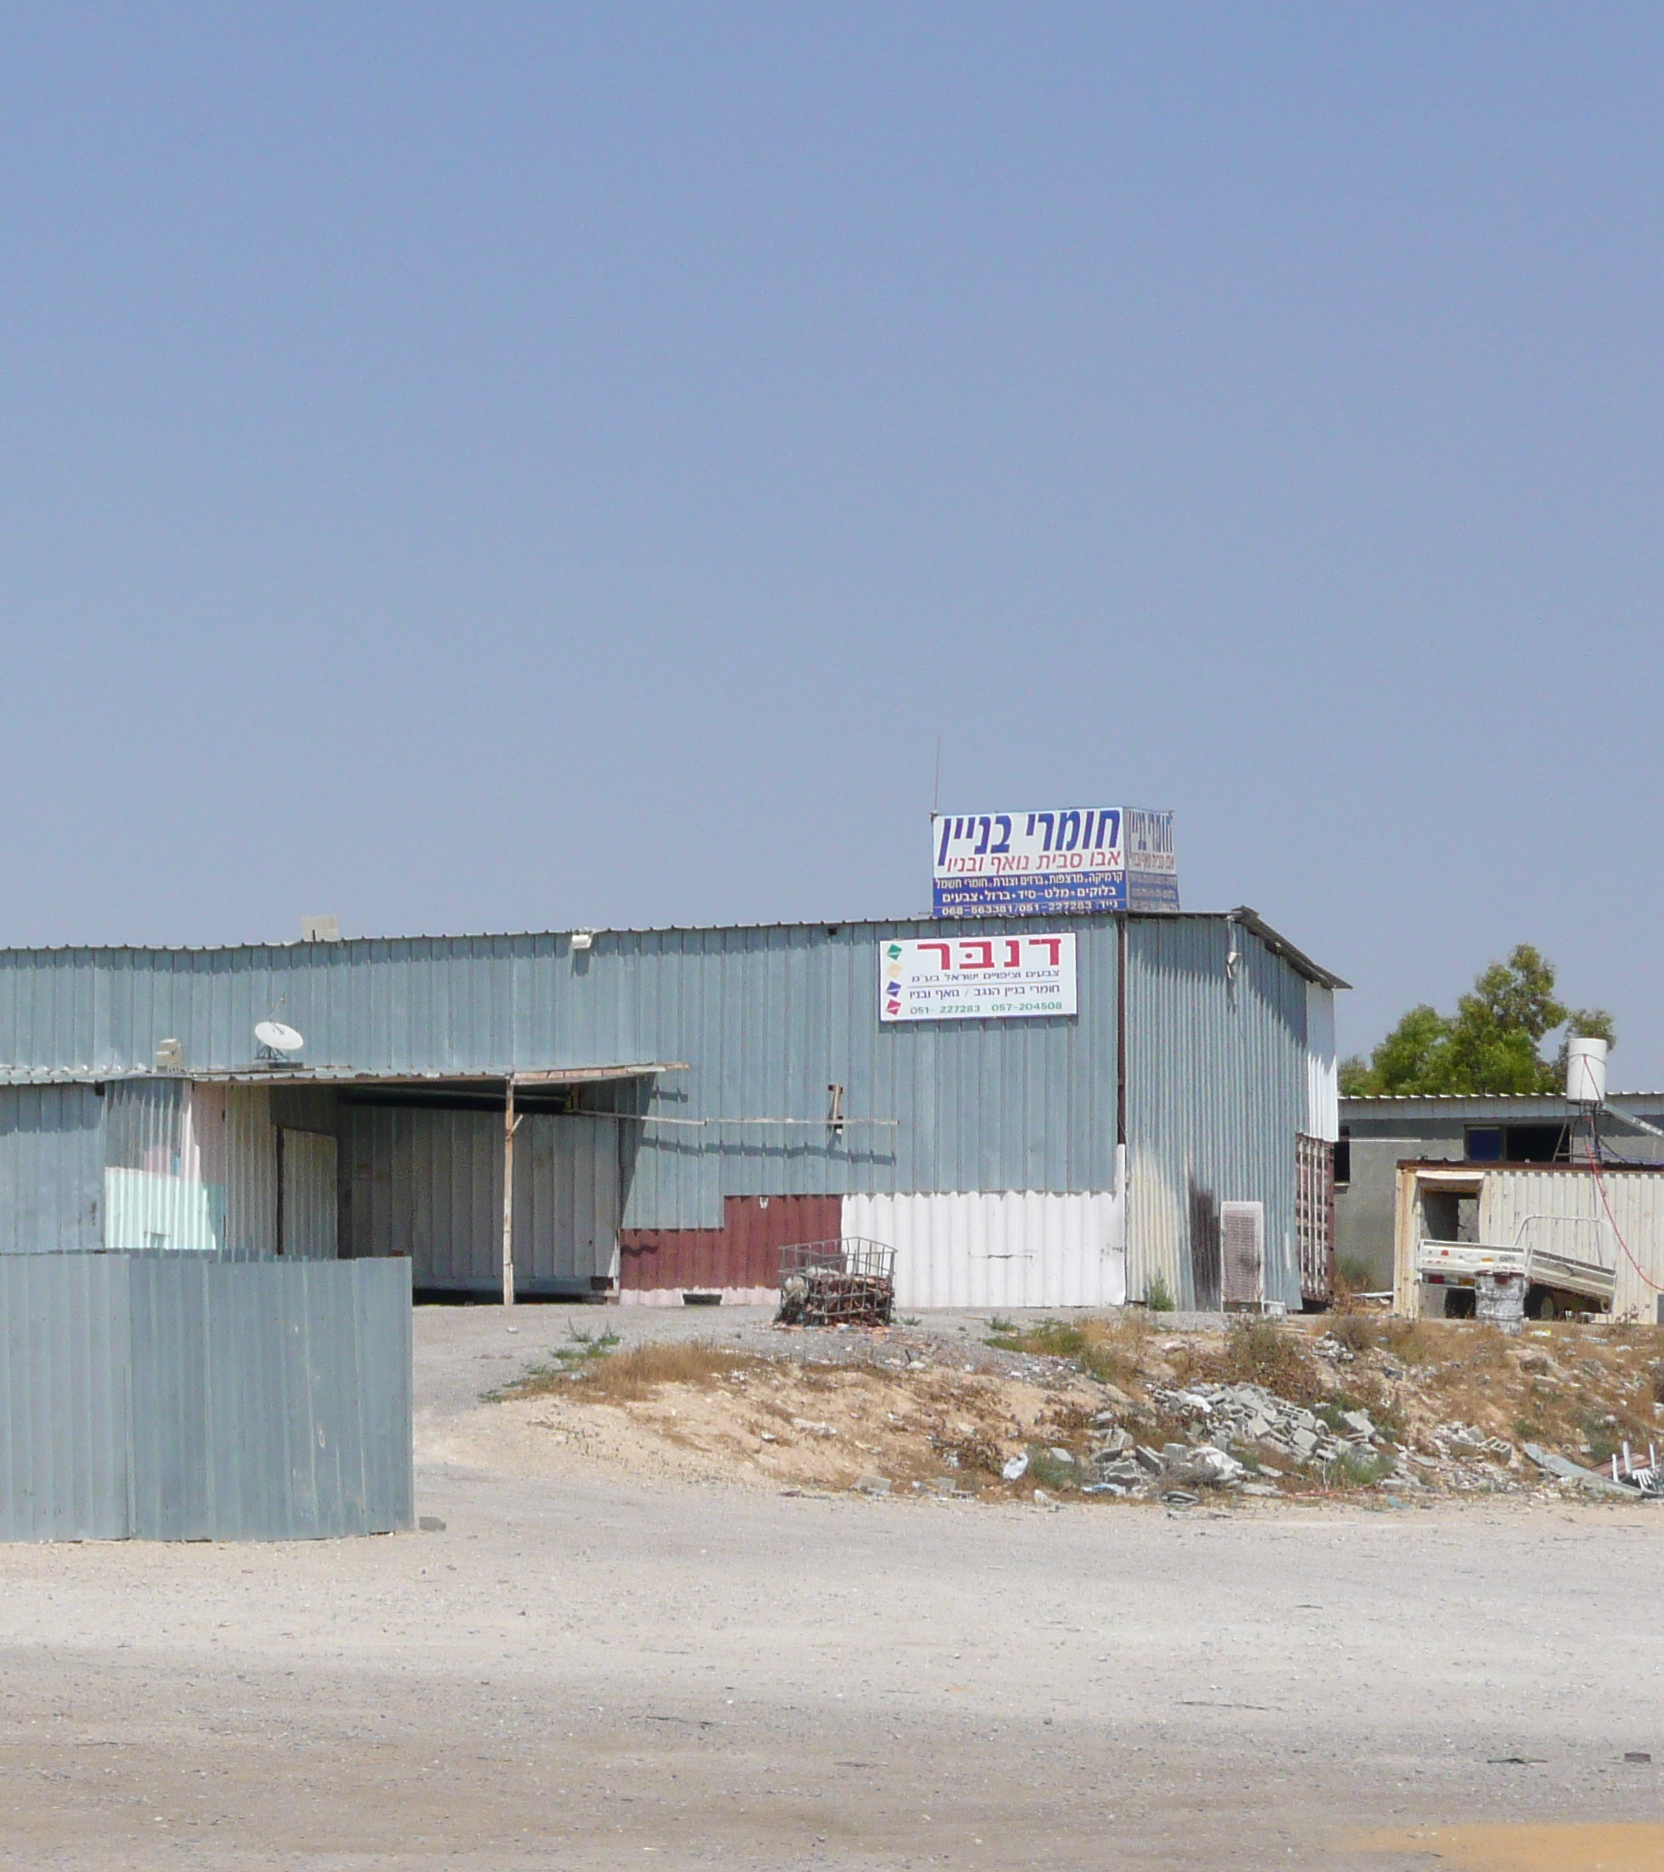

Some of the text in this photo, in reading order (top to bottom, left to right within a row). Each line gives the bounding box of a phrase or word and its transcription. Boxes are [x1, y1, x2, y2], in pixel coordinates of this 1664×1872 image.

[938, 810, 1121, 866] חומרי בניין
[947, 857, 984, 873] ובניו
[991, 855, 1030, 875] נואף
[1037, 852, 1083, 870] סבית
[1090, 851, 1121, 867] אבו
[943, 972, 979, 982] ישראל
[1026, 969, 1060, 978] צבעים
[1030, 984, 1060, 995] חומרי
